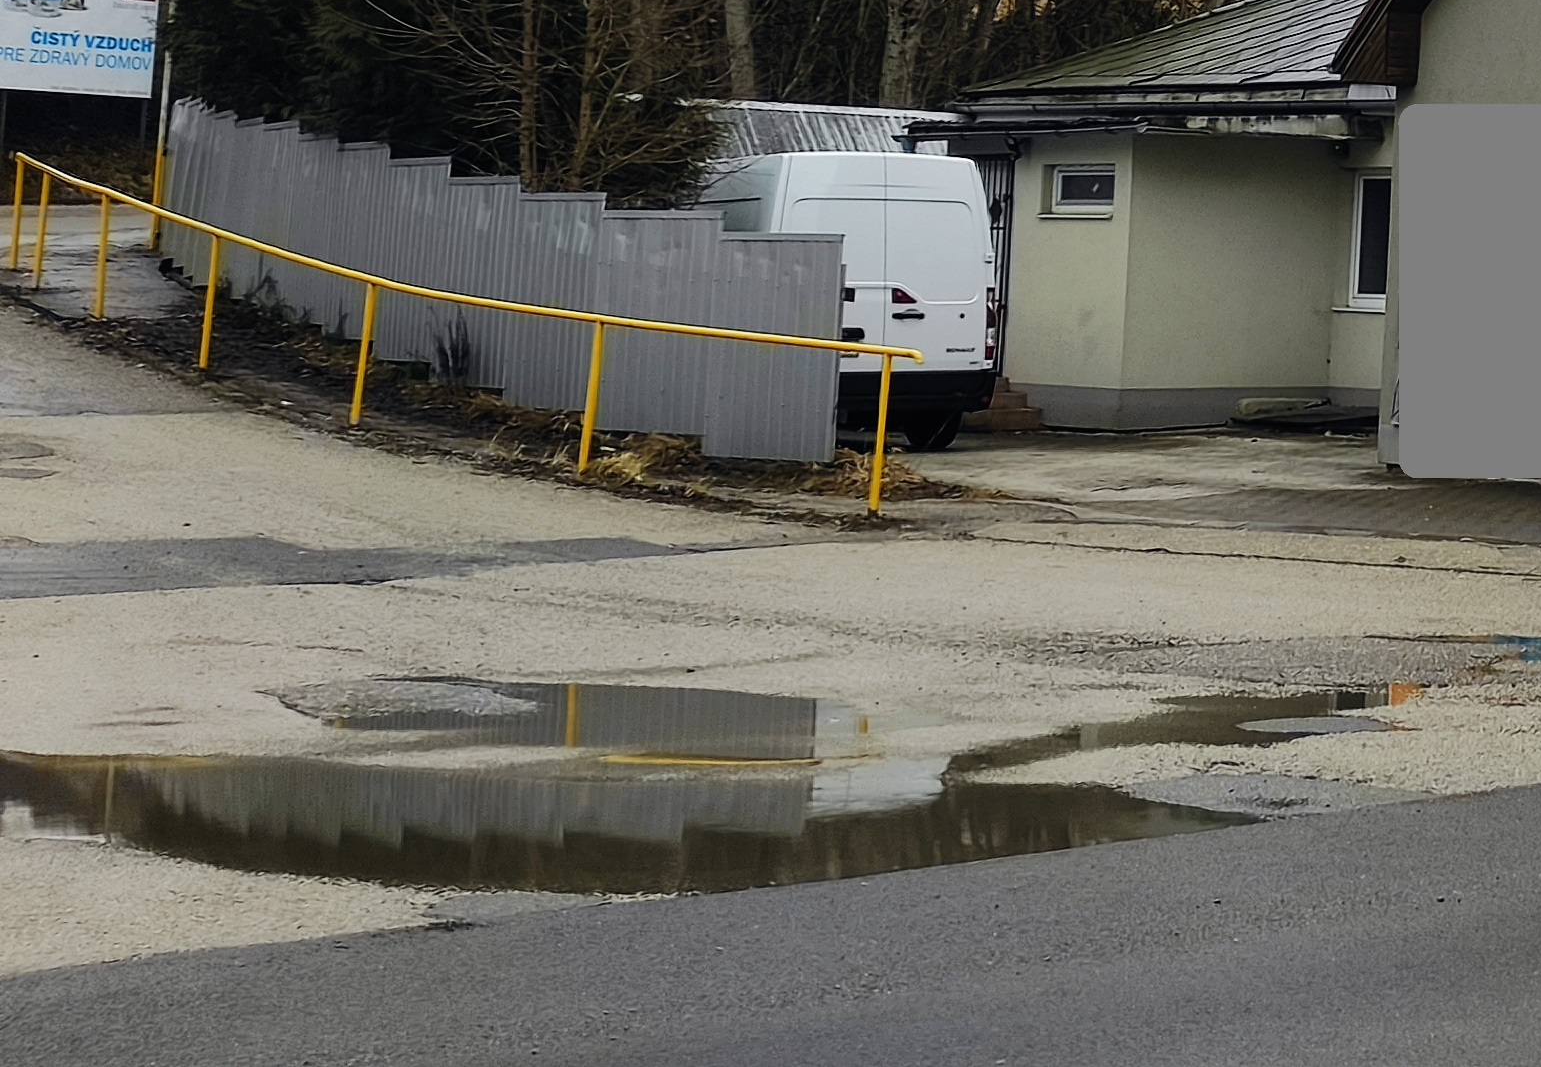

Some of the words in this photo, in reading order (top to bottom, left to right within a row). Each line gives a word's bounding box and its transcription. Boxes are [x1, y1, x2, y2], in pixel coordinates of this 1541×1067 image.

[30, 25, 80, 47] ČISTÝ
[84, 34, 154, 53] VZDUCH
[95, 52, 152, 71] DOMOV
